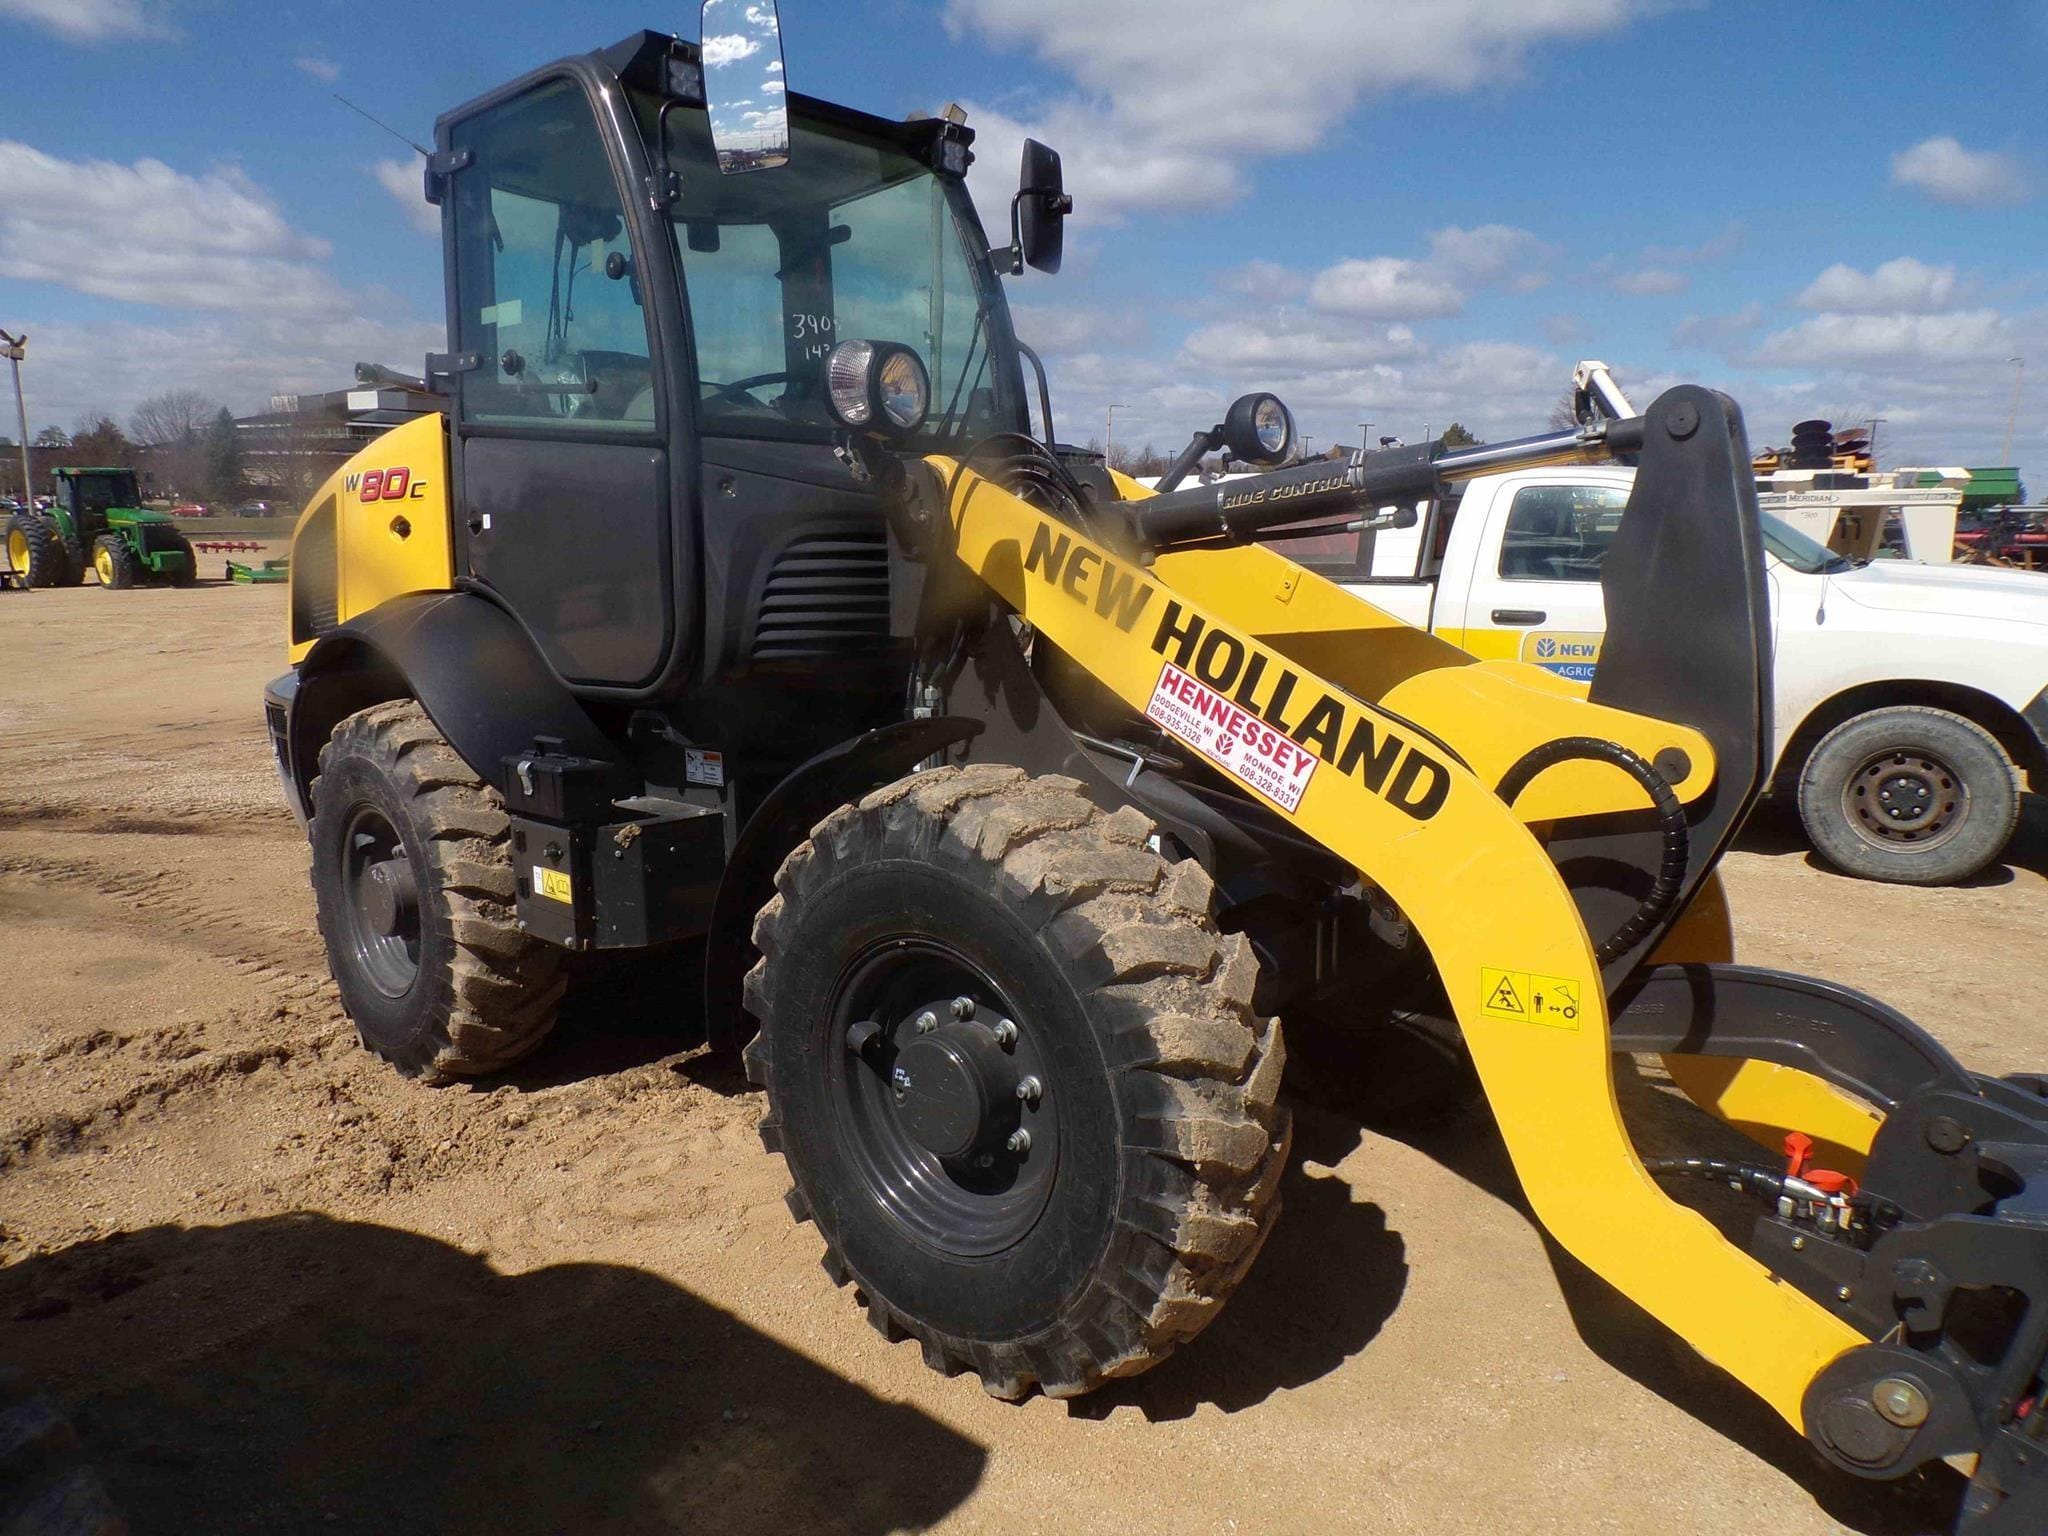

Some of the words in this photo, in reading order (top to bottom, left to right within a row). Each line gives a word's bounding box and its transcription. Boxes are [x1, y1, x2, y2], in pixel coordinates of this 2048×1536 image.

[1789, 494, 1833, 503] MERIDIAN
[1560, 644, 1595, 656] NEW
[1024, 520, 1155, 635] NEW
[1151, 599, 1451, 822] HOLLAND
[1149, 704, 1202, 745] 608-935-3326
[1160, 668, 1312, 777] HENNESSEY
[1203, 724, 1214, 738] WI
[1239, 764, 1295, 808] 608-328-8331
[1288, 781, 1301, 796] WI
